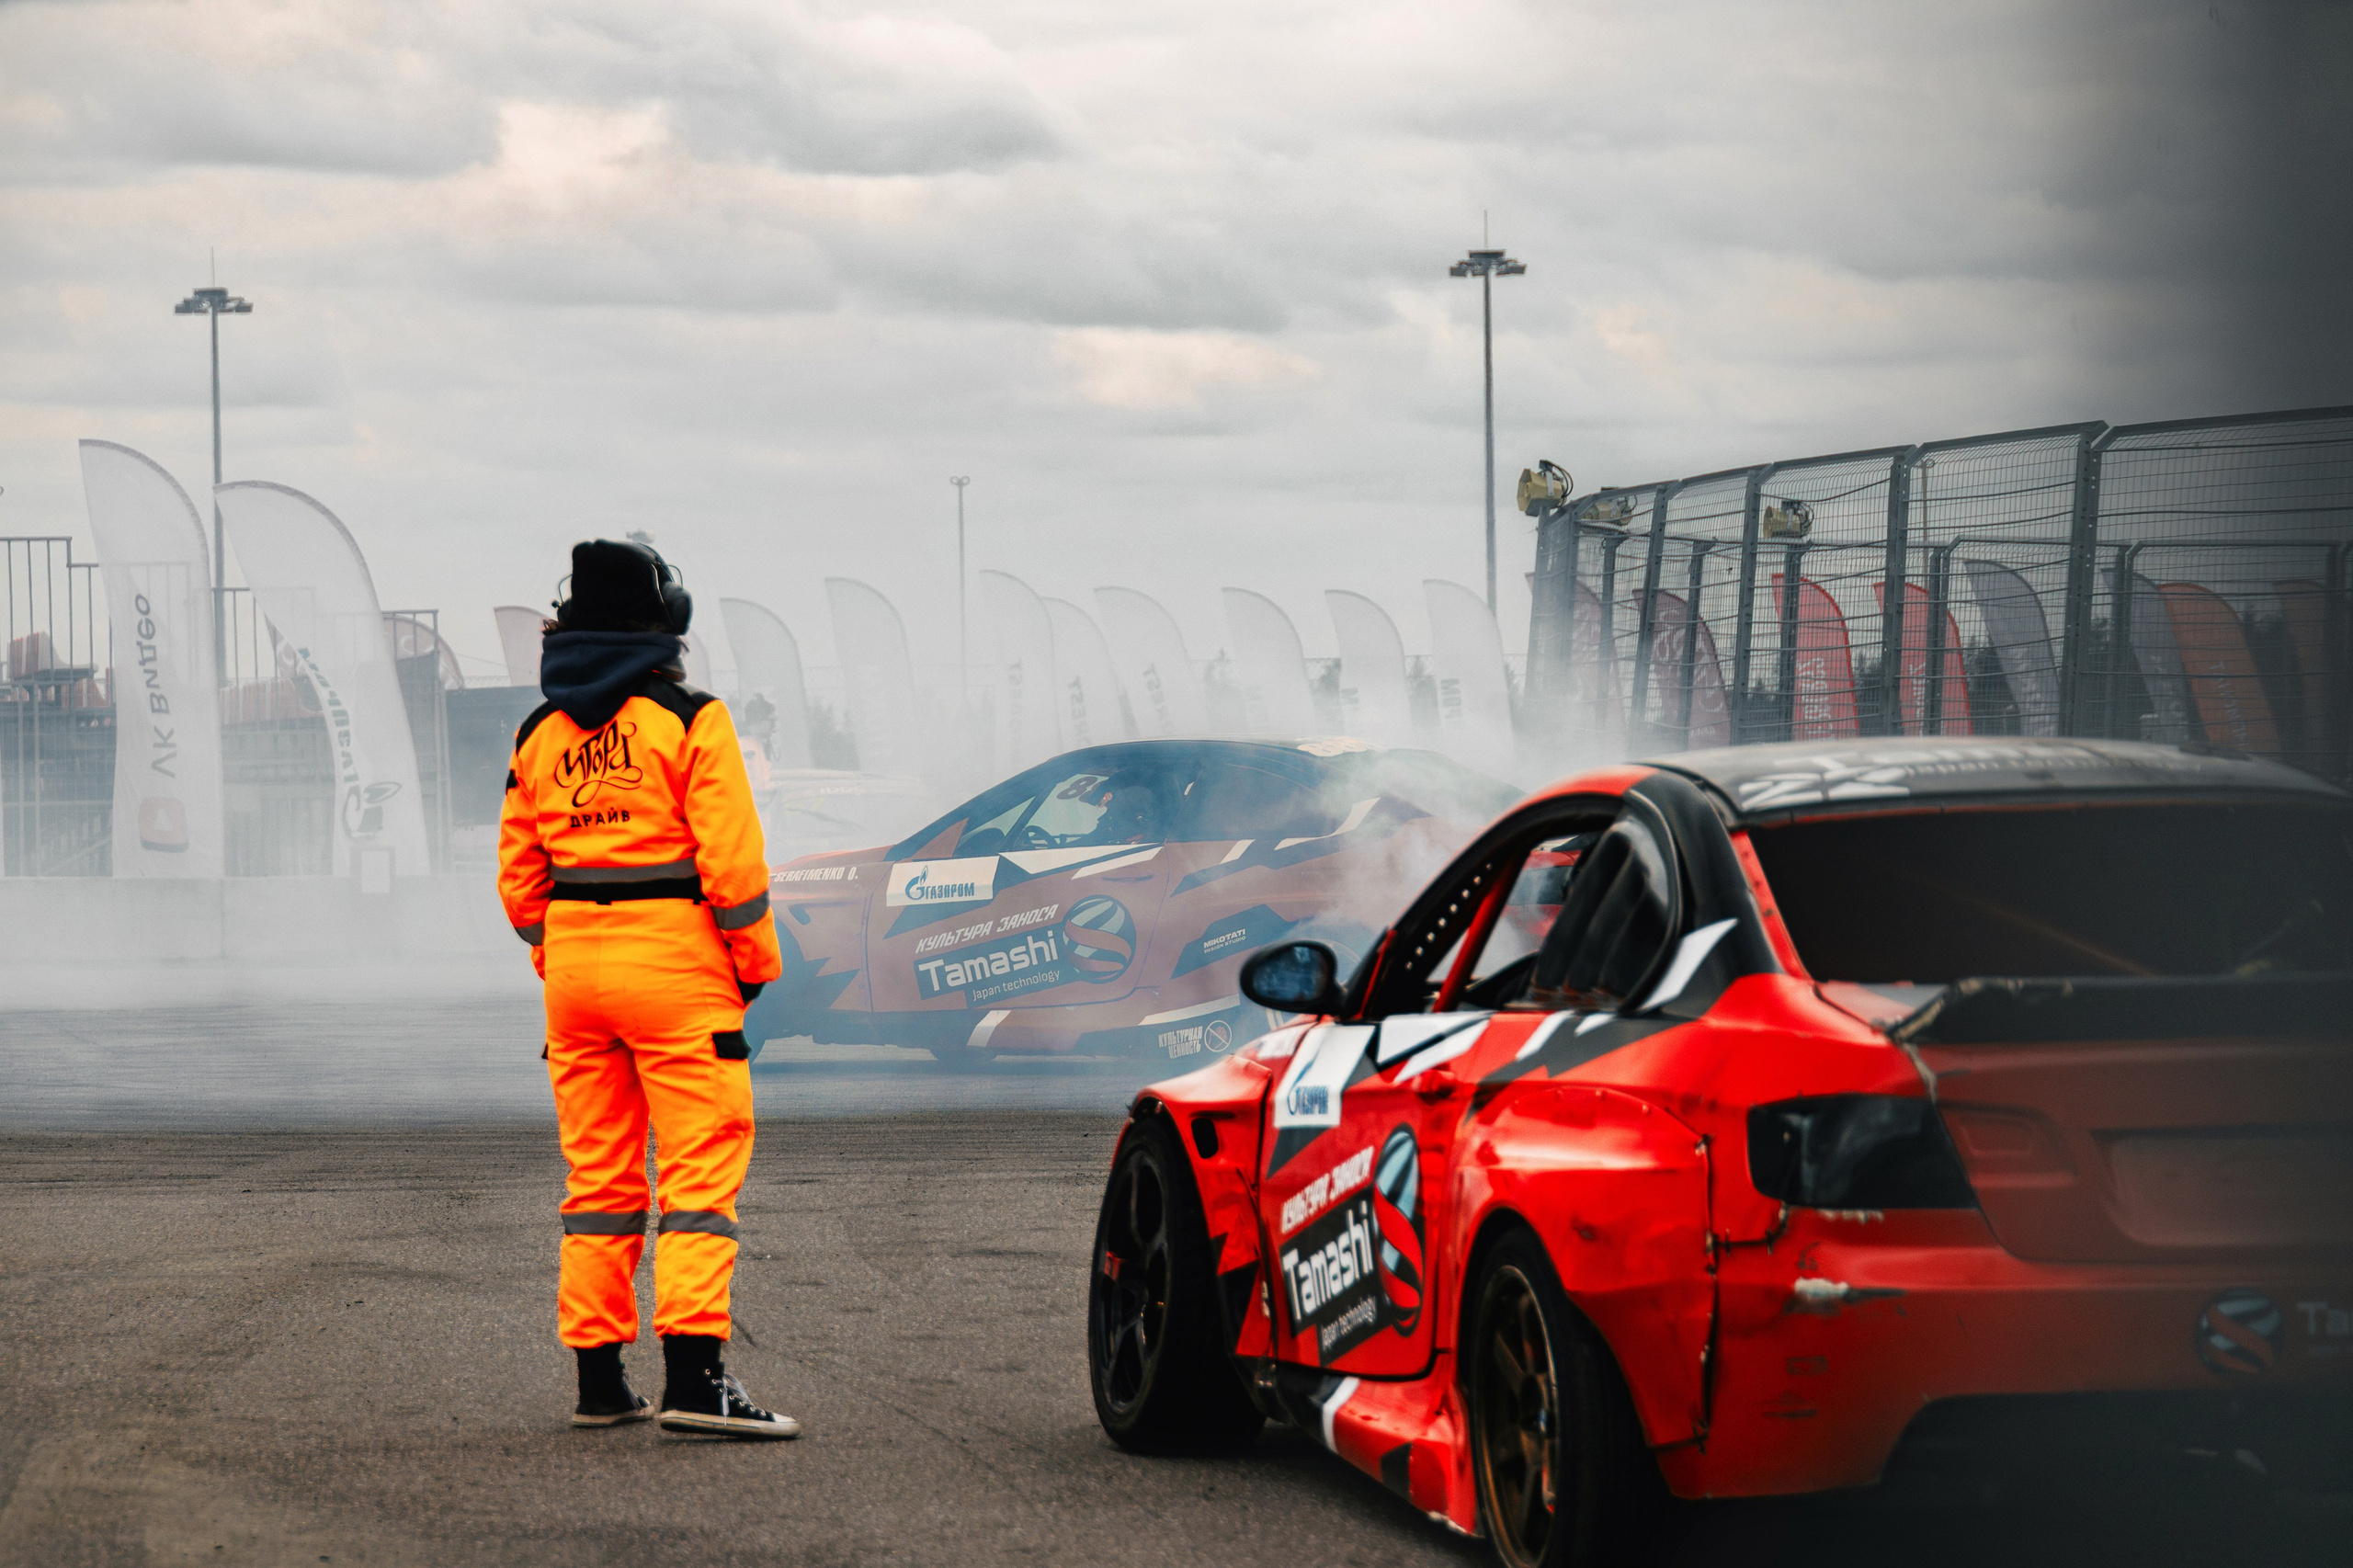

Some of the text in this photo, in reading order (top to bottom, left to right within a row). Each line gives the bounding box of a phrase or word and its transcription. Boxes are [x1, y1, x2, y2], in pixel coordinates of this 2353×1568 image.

[570, 807, 631, 828] ДРАЙВ
[774, 867, 843, 882] SERAFIMENKO
[925, 882, 975, 900] ГАЗПРОМ
[915, 903, 1059, 954] КУЛЬТУРА ЗАНОСА
[1203, 928, 1246, 949] MIKOTATI
[1204, 936, 1246, 954] DESIGN STUDIO
[919, 930, 1059, 991] Tamashi
[972, 969, 1060, 1001] Japan technology
[1158, 1026, 1203, 1047] КУЛЬТУРНАЯ
[1167, 1039, 1201, 1059] ЦЕННОСТЬ
[1282, 1199, 1374, 1323] Tamashi
